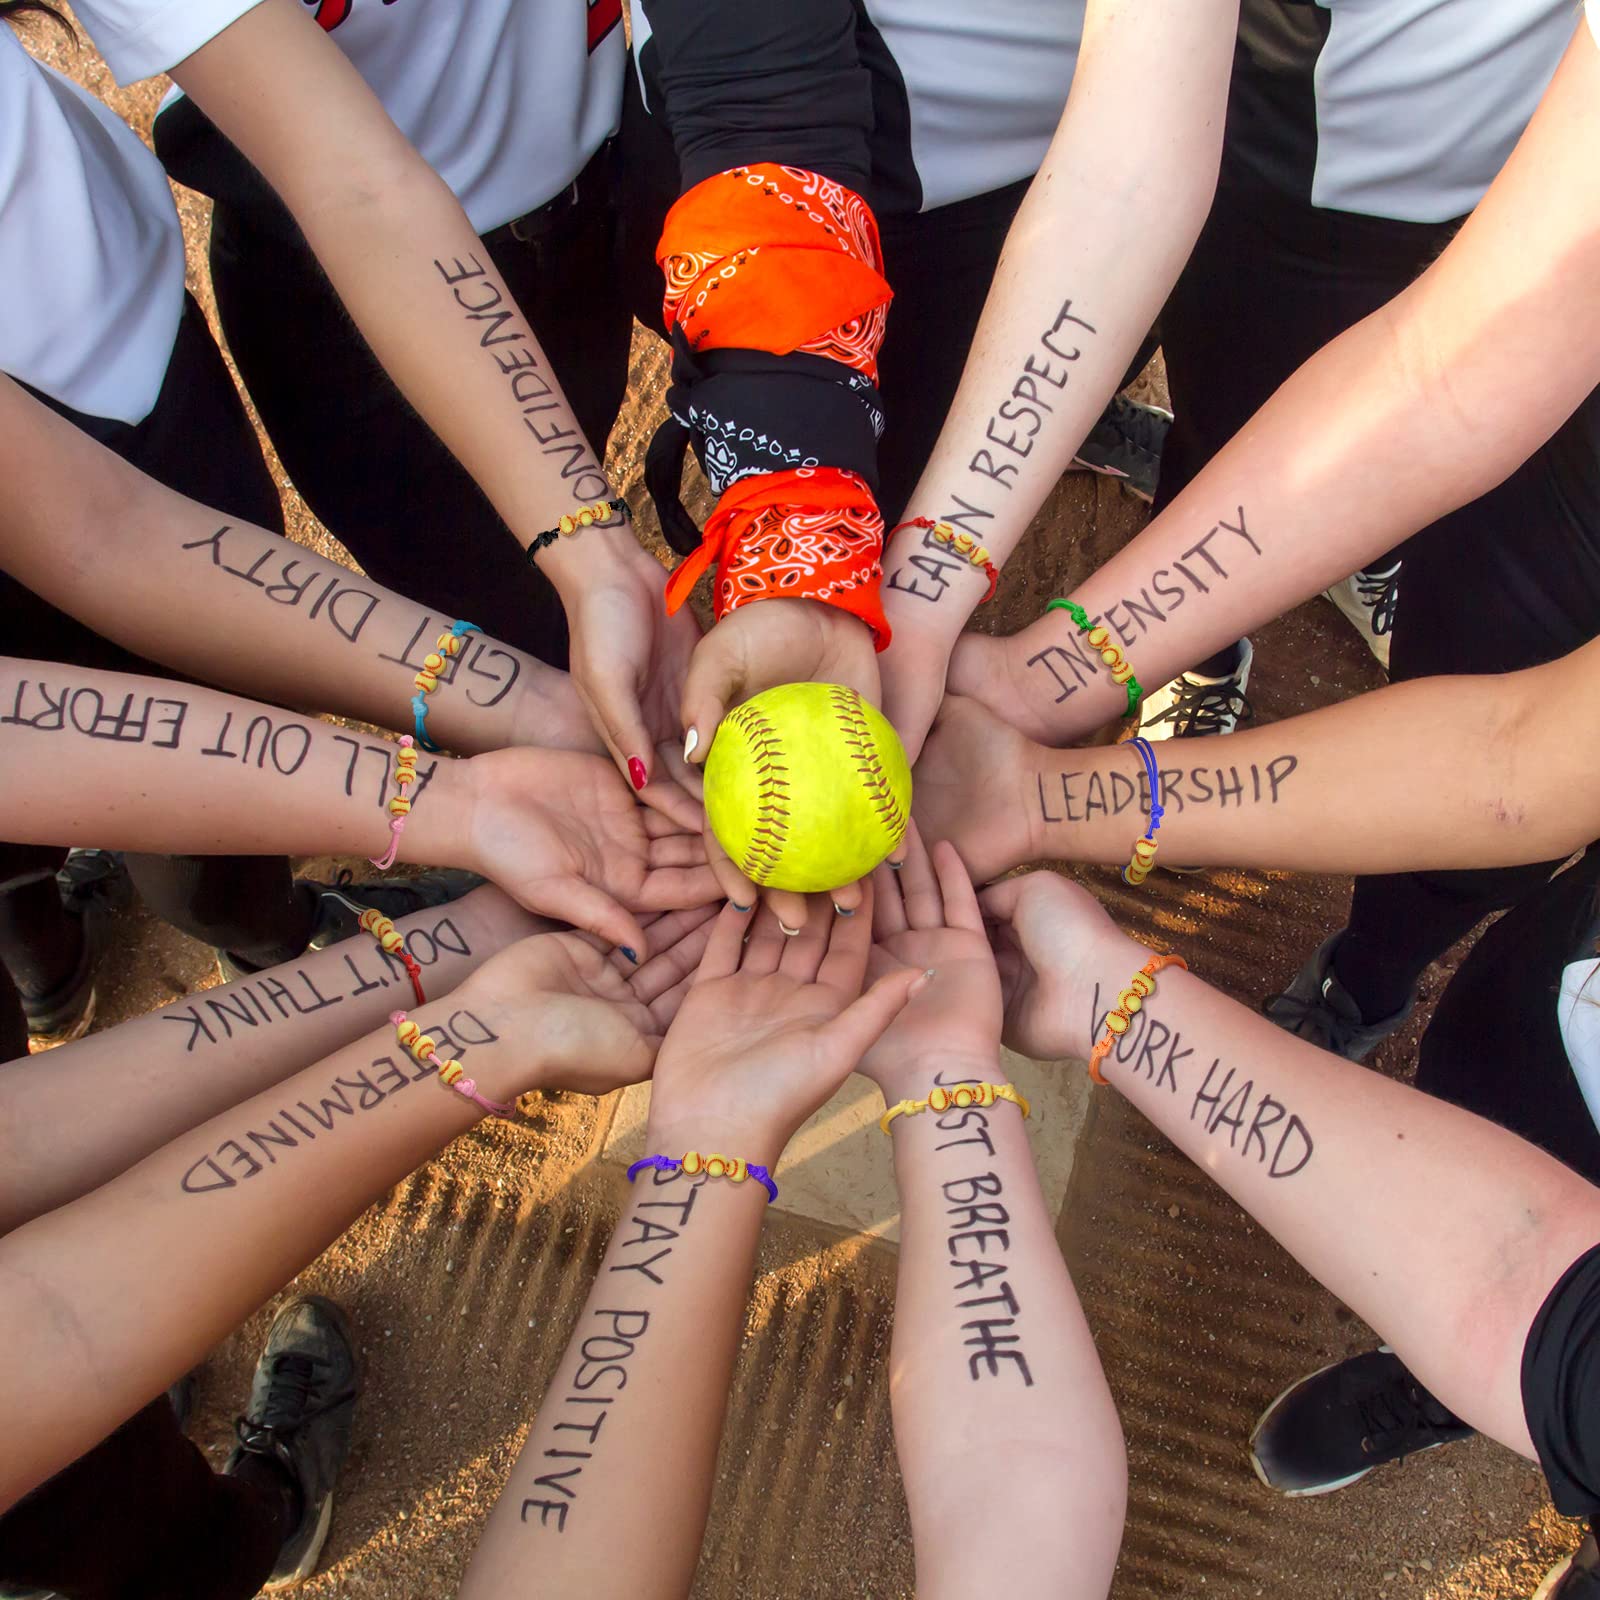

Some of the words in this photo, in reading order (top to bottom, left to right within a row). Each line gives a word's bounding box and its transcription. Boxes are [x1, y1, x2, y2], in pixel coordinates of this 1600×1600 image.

[968, 299, 1097, 490] RESPECT
[182, 525, 380, 642] DIRTY
[1, 680, 188, 749] EFFORT
[378, 617, 522, 708] GET
[201, 711, 311, 775] OUT
[1037, 755, 1298, 823] LEADERSHIP
[163, 968, 344, 1051] THINK
[180, 1009, 498, 1194] DETERMINED
[1190, 1058, 1314, 1178] HARD
[942, 1171, 1034, 1387] BREATHE
[520, 1309, 650, 1533] POSITIVE
